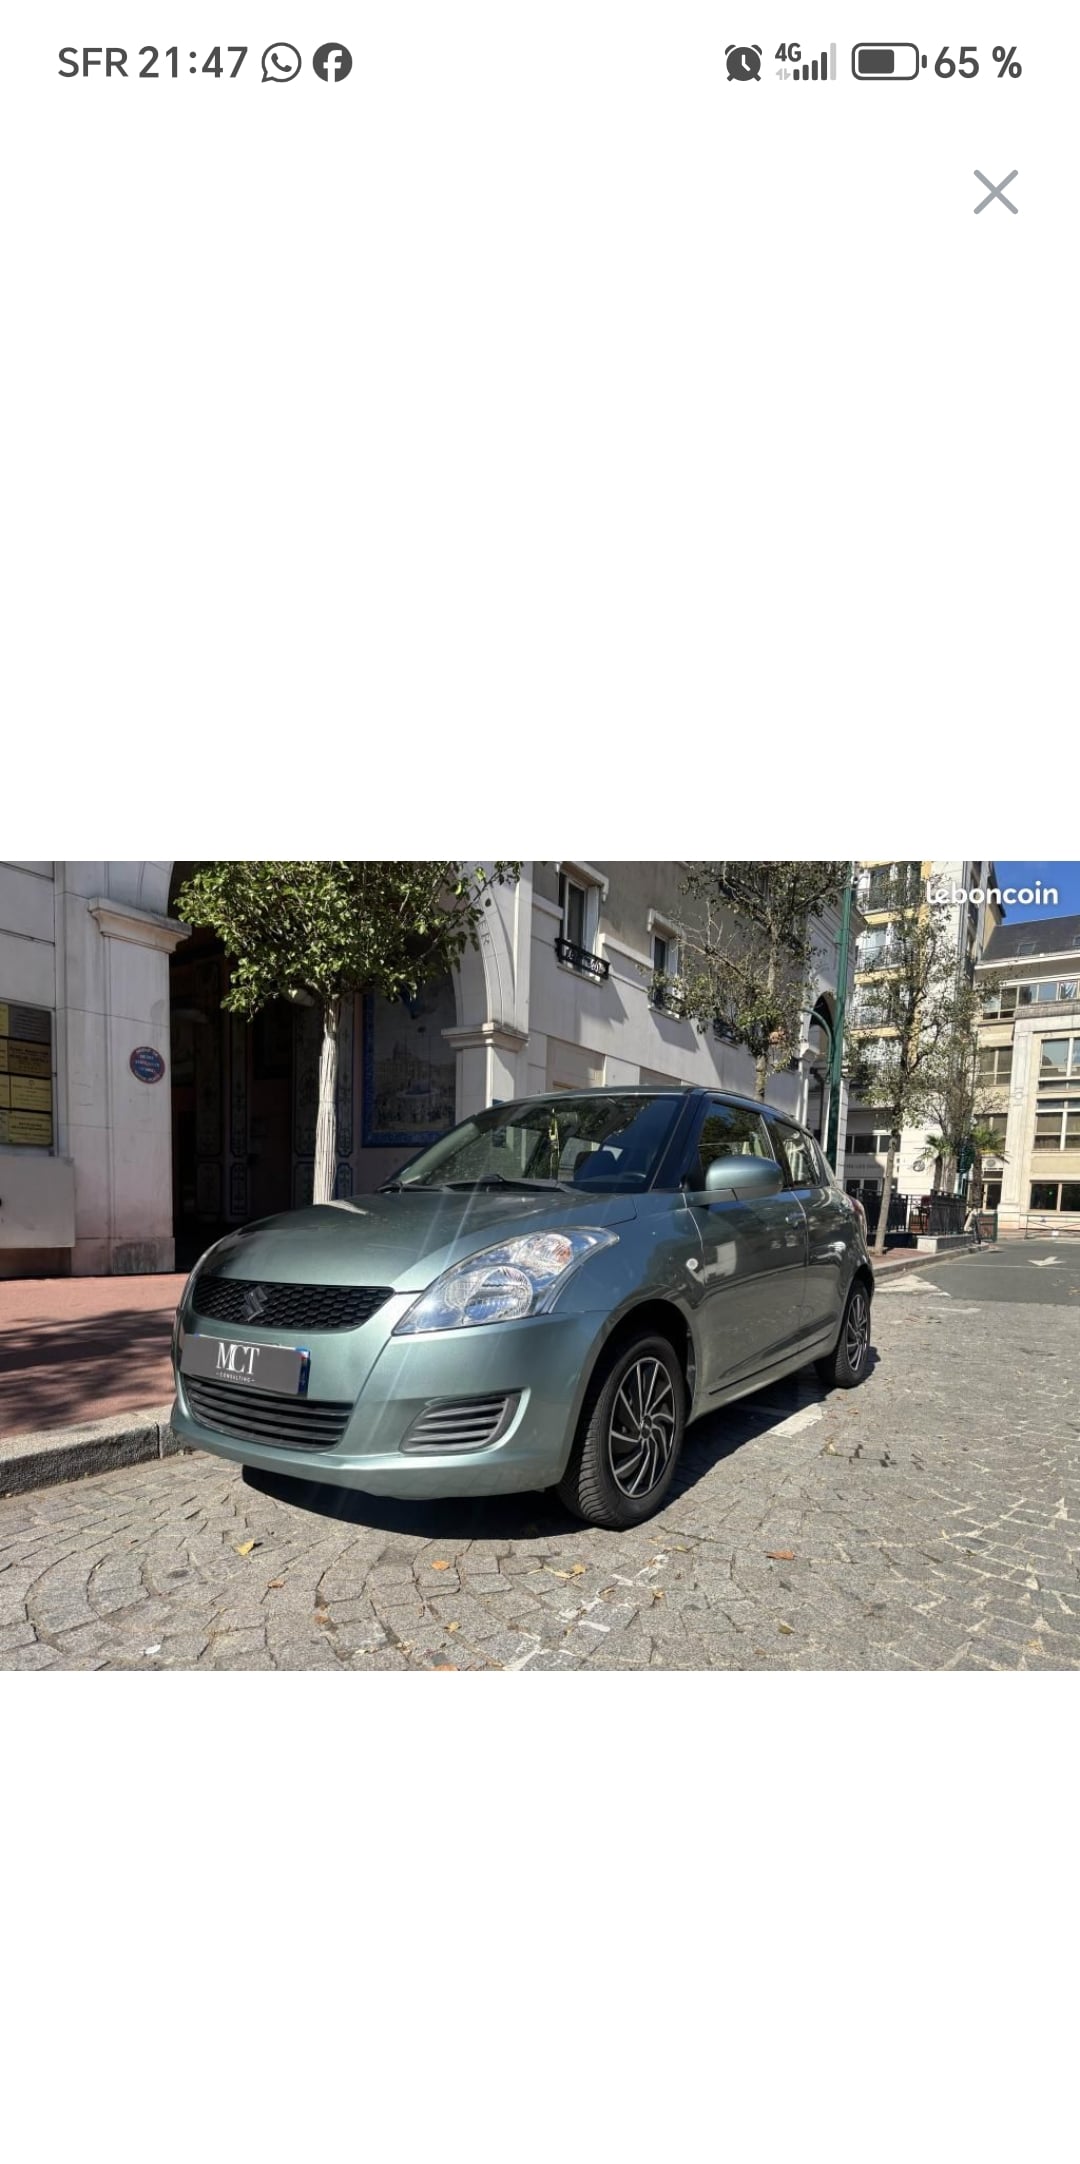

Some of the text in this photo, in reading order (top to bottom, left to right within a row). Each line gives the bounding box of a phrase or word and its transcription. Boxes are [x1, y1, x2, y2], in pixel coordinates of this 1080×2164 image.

[58, 46, 247, 77] SFR 21:47
[774, 43, 802, 62] 4G
[935, 46, 1022, 78] 65 %
